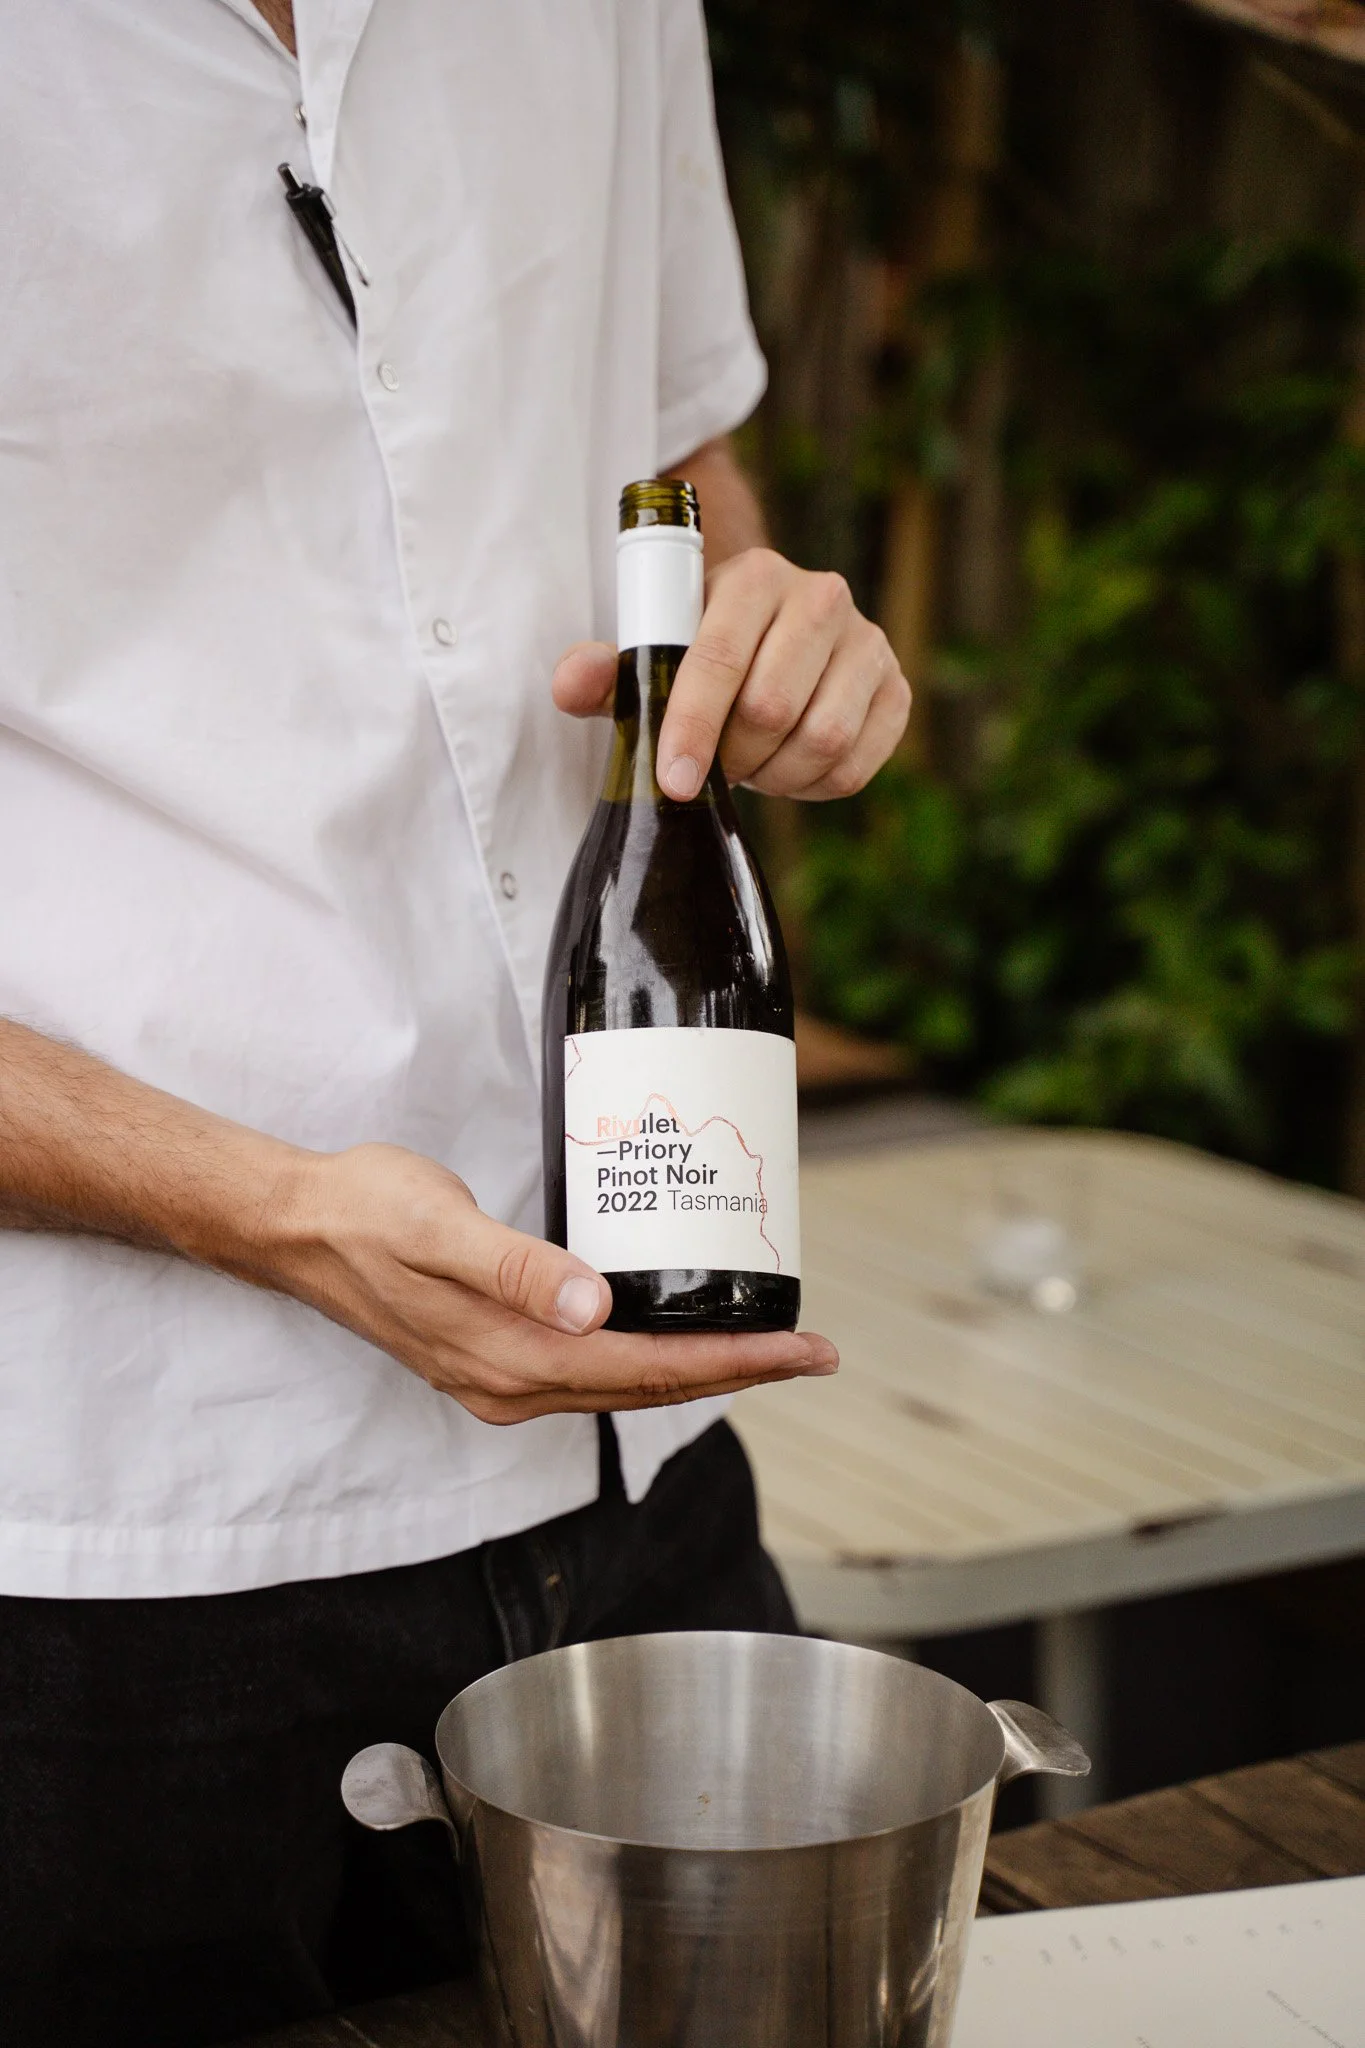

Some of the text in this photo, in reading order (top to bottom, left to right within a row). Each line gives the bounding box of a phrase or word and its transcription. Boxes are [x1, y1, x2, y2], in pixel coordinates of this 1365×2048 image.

[596, 1112, 680, 1138] Rivulet
[597, 1163, 718, 1188] Pinot Noir
[597, 1189, 768, 1214] 2022 Tasmania
